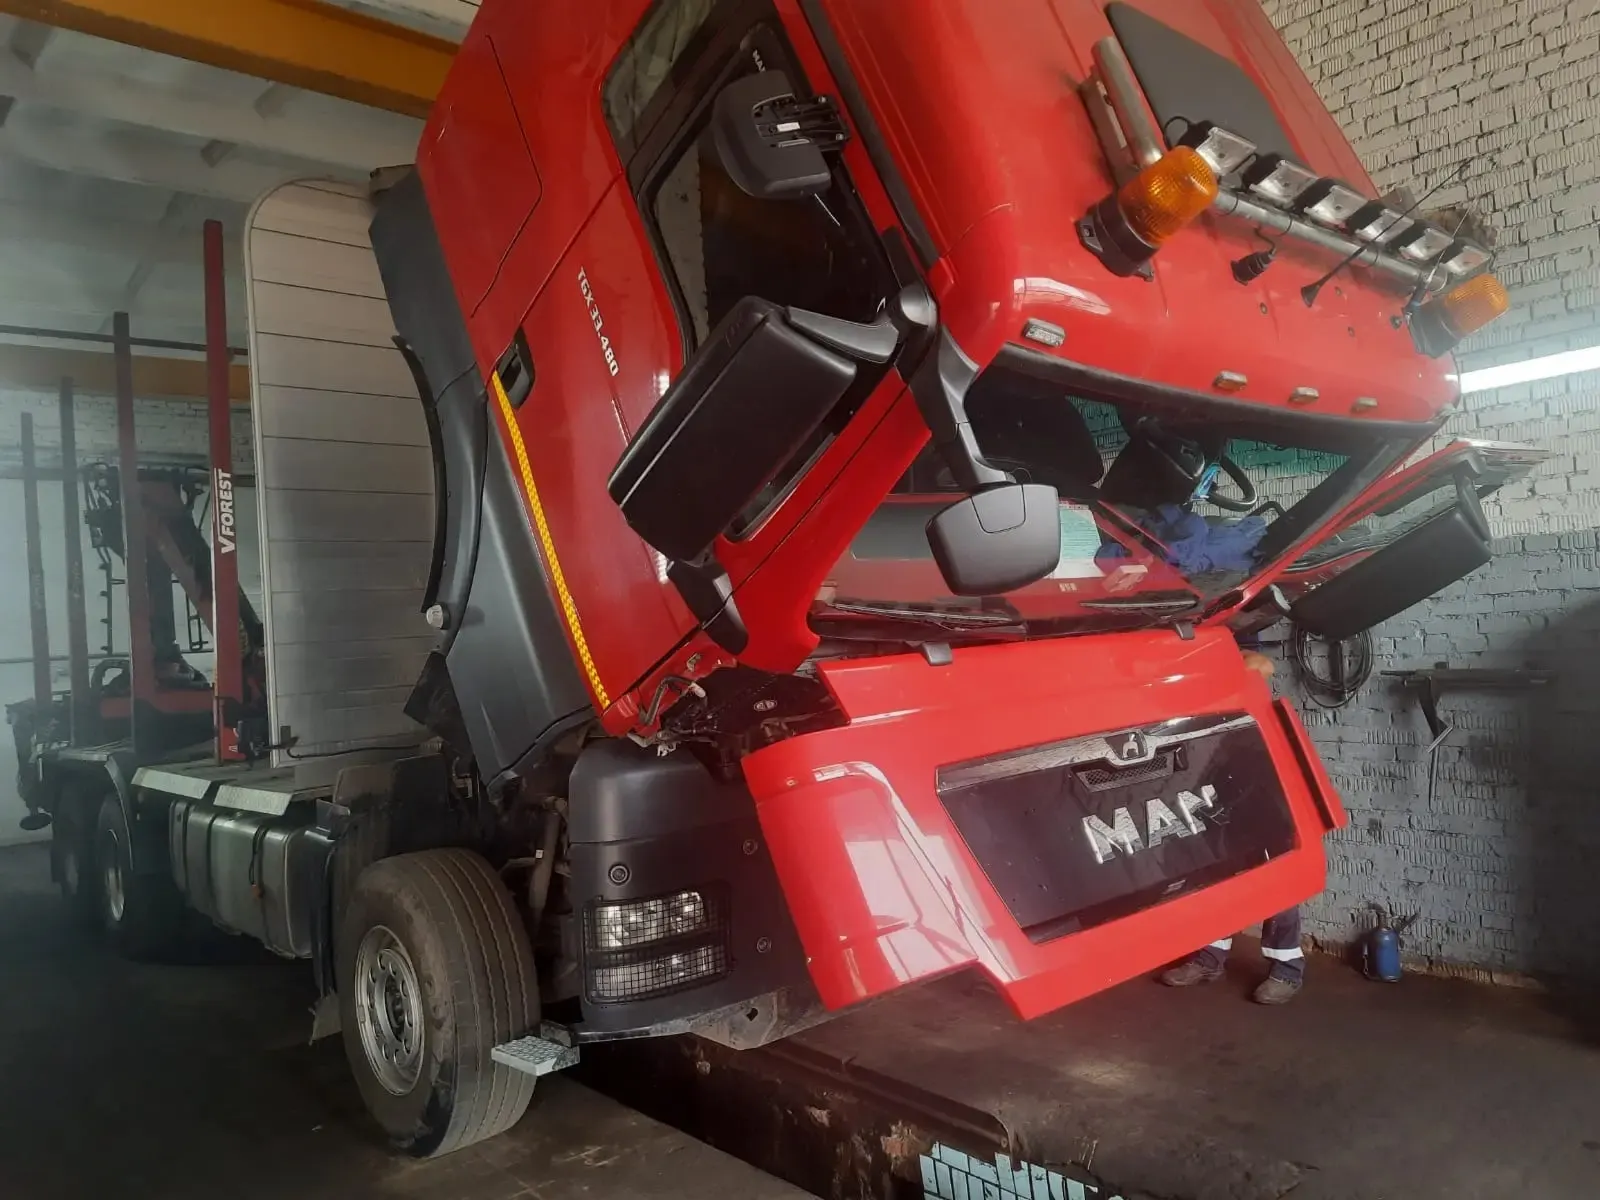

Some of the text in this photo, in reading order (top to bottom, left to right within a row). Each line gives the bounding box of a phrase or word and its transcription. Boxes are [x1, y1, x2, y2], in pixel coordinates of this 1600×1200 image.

[577, 265, 619, 377] TGX 33.480
[1082, 784, 1219, 864] MAN
